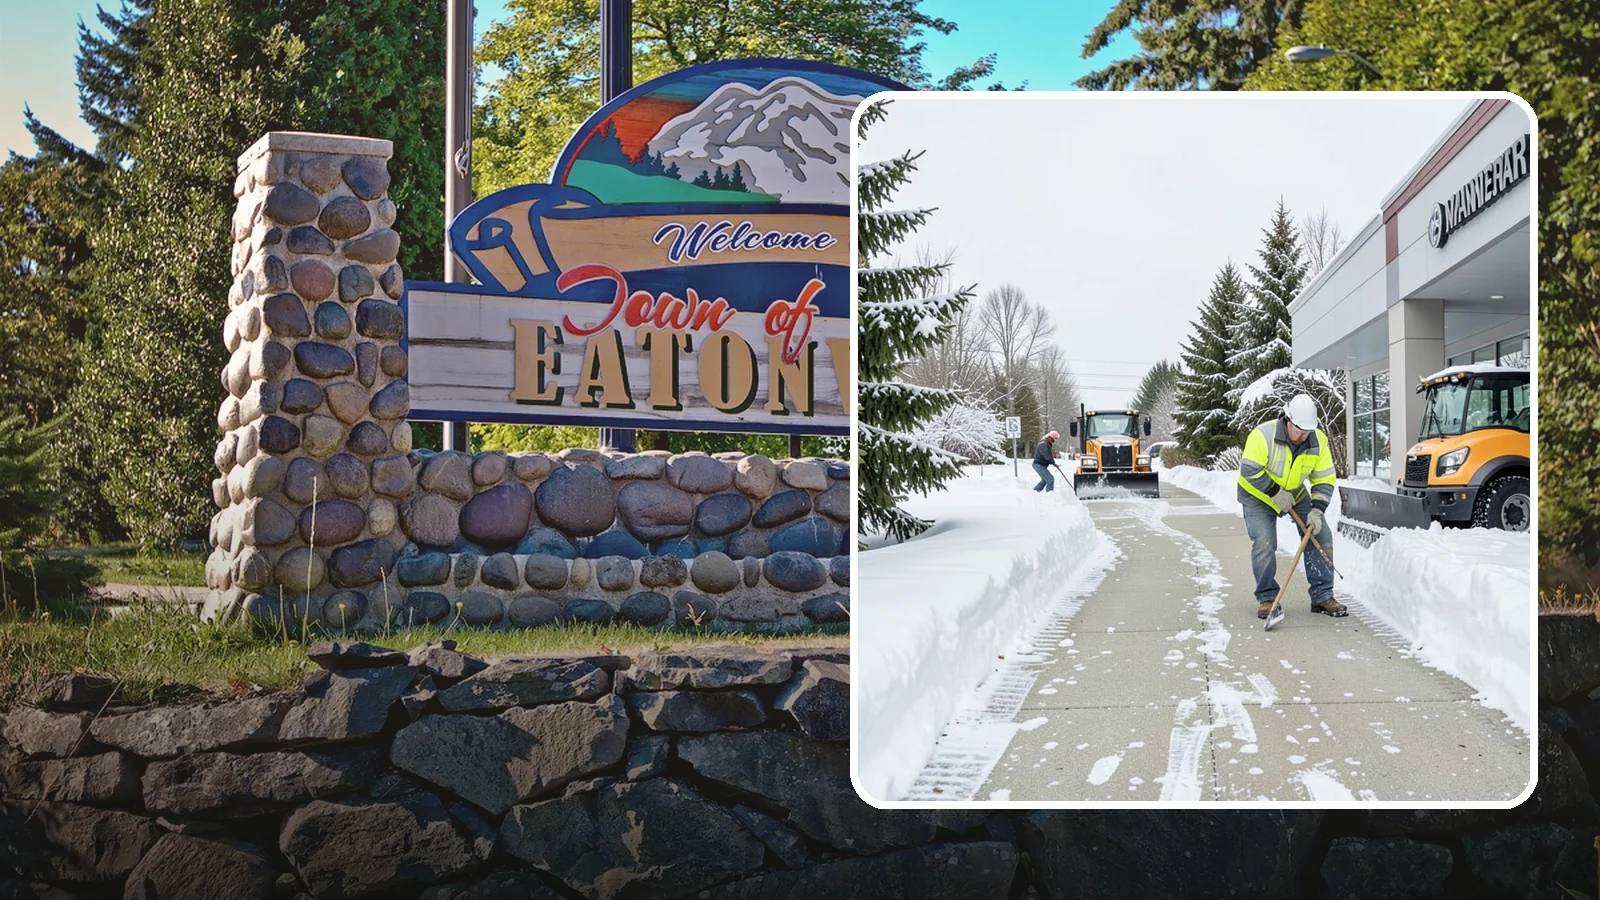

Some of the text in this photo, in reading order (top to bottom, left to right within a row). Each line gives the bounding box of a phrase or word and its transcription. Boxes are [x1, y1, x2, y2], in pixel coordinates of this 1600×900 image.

[653, 220, 837, 263] Welcome
[556, 263, 826, 366] Town of
